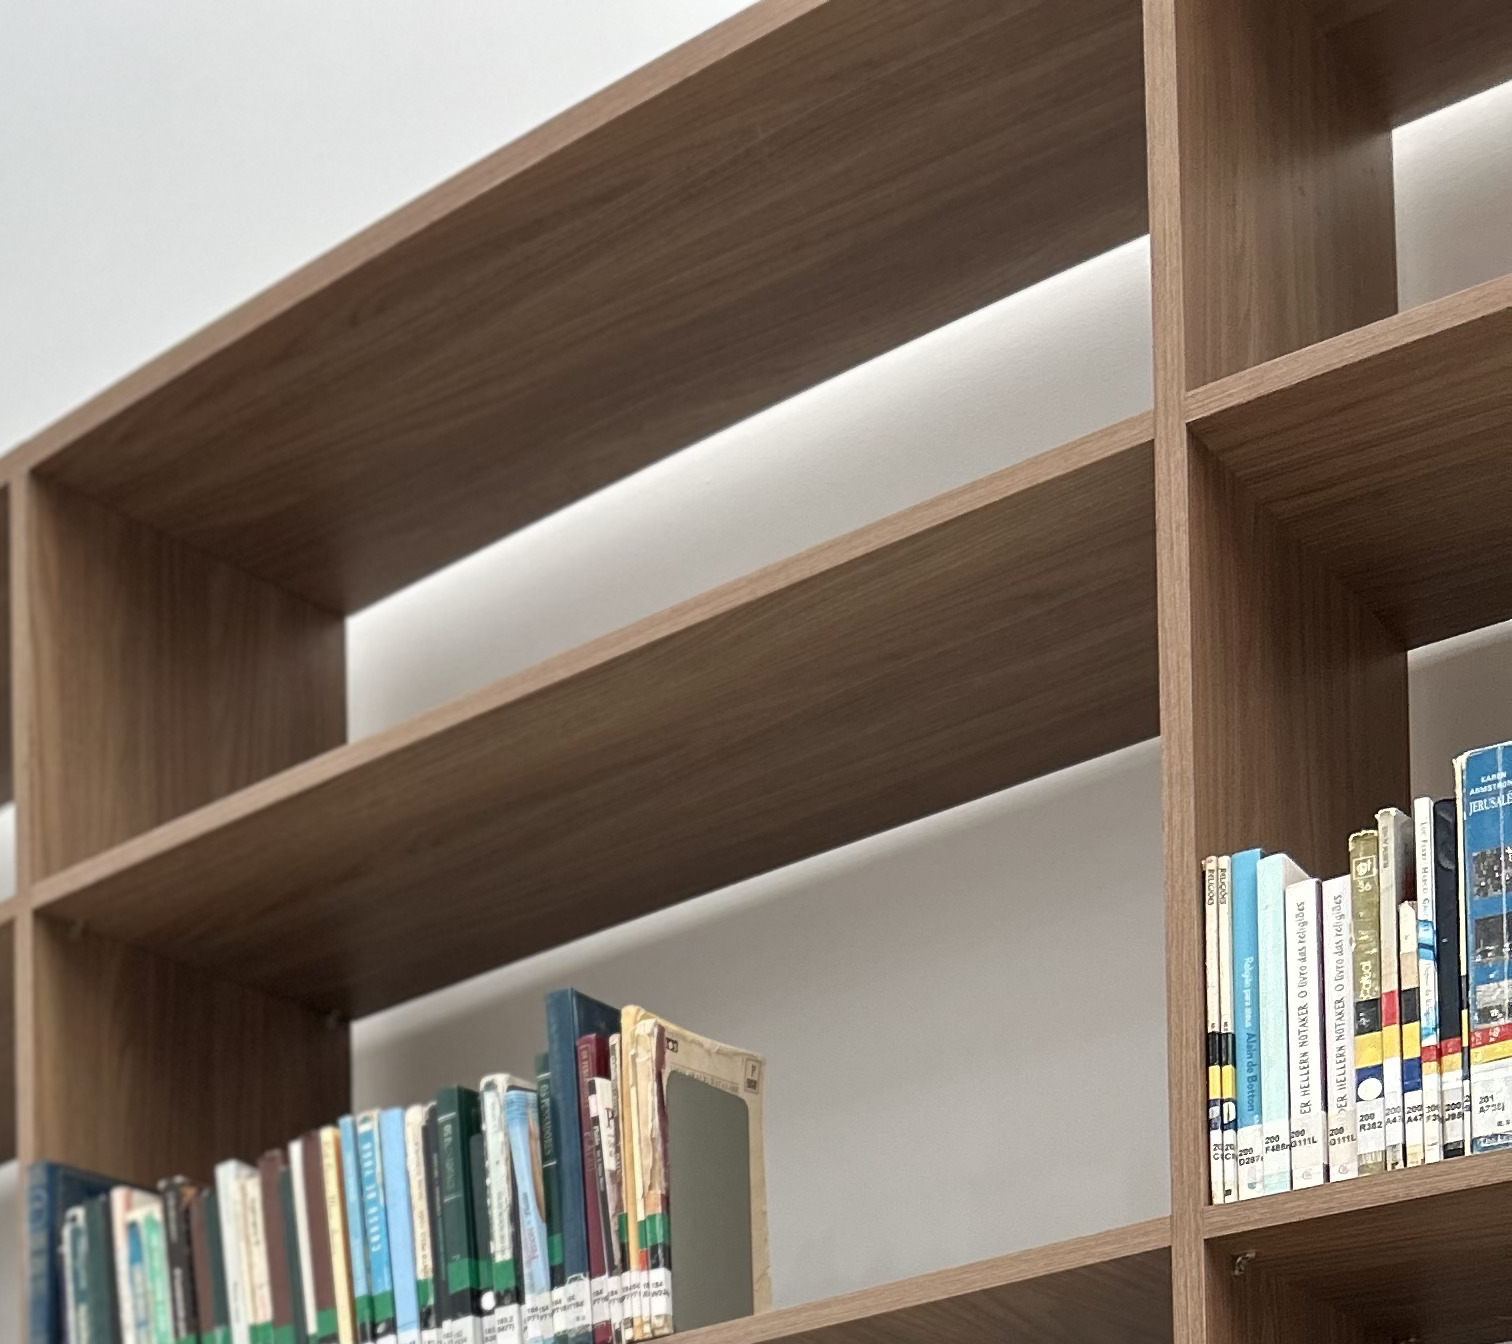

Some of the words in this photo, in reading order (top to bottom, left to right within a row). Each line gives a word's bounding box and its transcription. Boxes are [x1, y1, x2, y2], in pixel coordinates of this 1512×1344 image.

[1469, 792, 1512, 816] JERUSALÉ
[1297, 945, 1307, 962] das
[1334, 938, 1344, 956] das
[1298, 1002, 1309, 1047] NOTAKER
[1299, 1051, 1310, 1097] HELLERN
